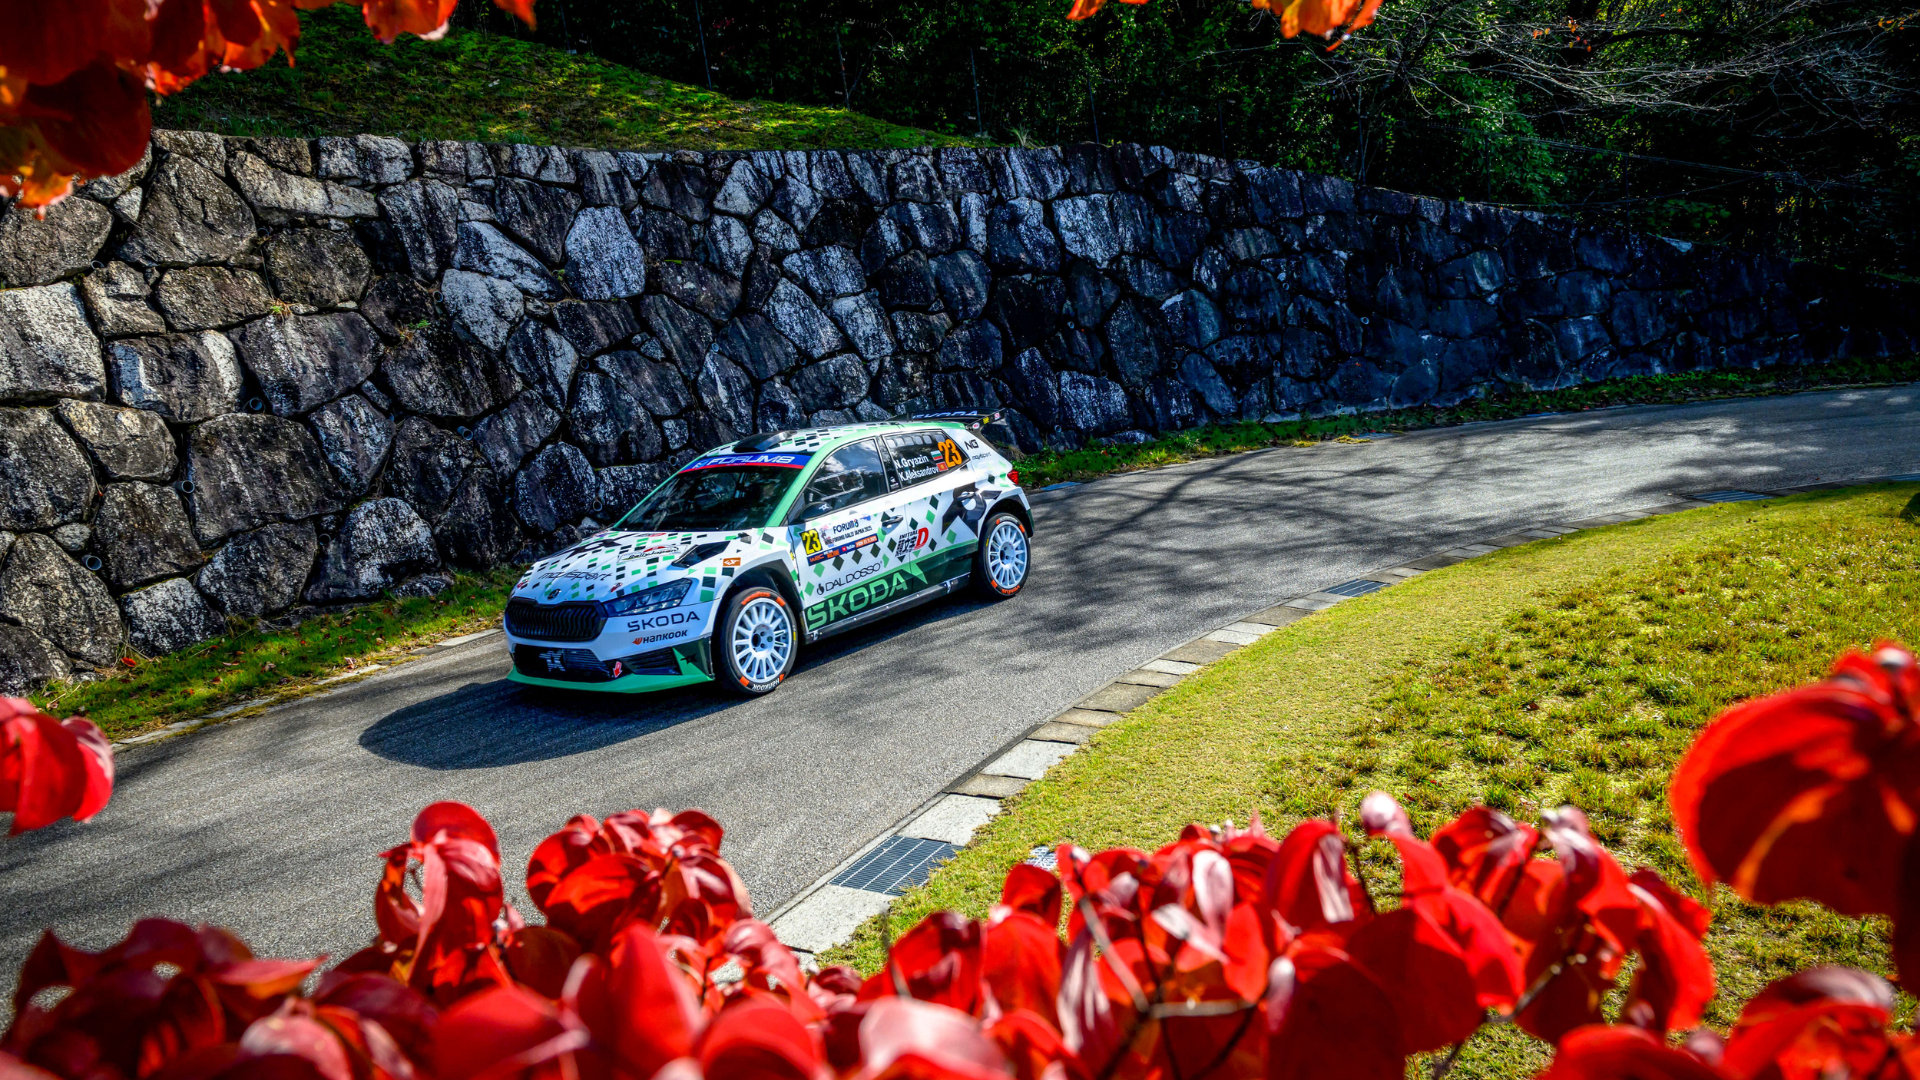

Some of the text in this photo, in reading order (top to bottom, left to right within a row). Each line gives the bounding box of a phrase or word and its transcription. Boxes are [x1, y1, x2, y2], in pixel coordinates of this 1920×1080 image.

[937, 438, 963, 468] 23
[964, 439, 979, 450] NG
[707, 455, 796, 466] FORUM8
[832, 518, 859, 534] FORUM8
[801, 529, 822, 555] 23
[825, 562, 881, 592] DAL DOSSO
